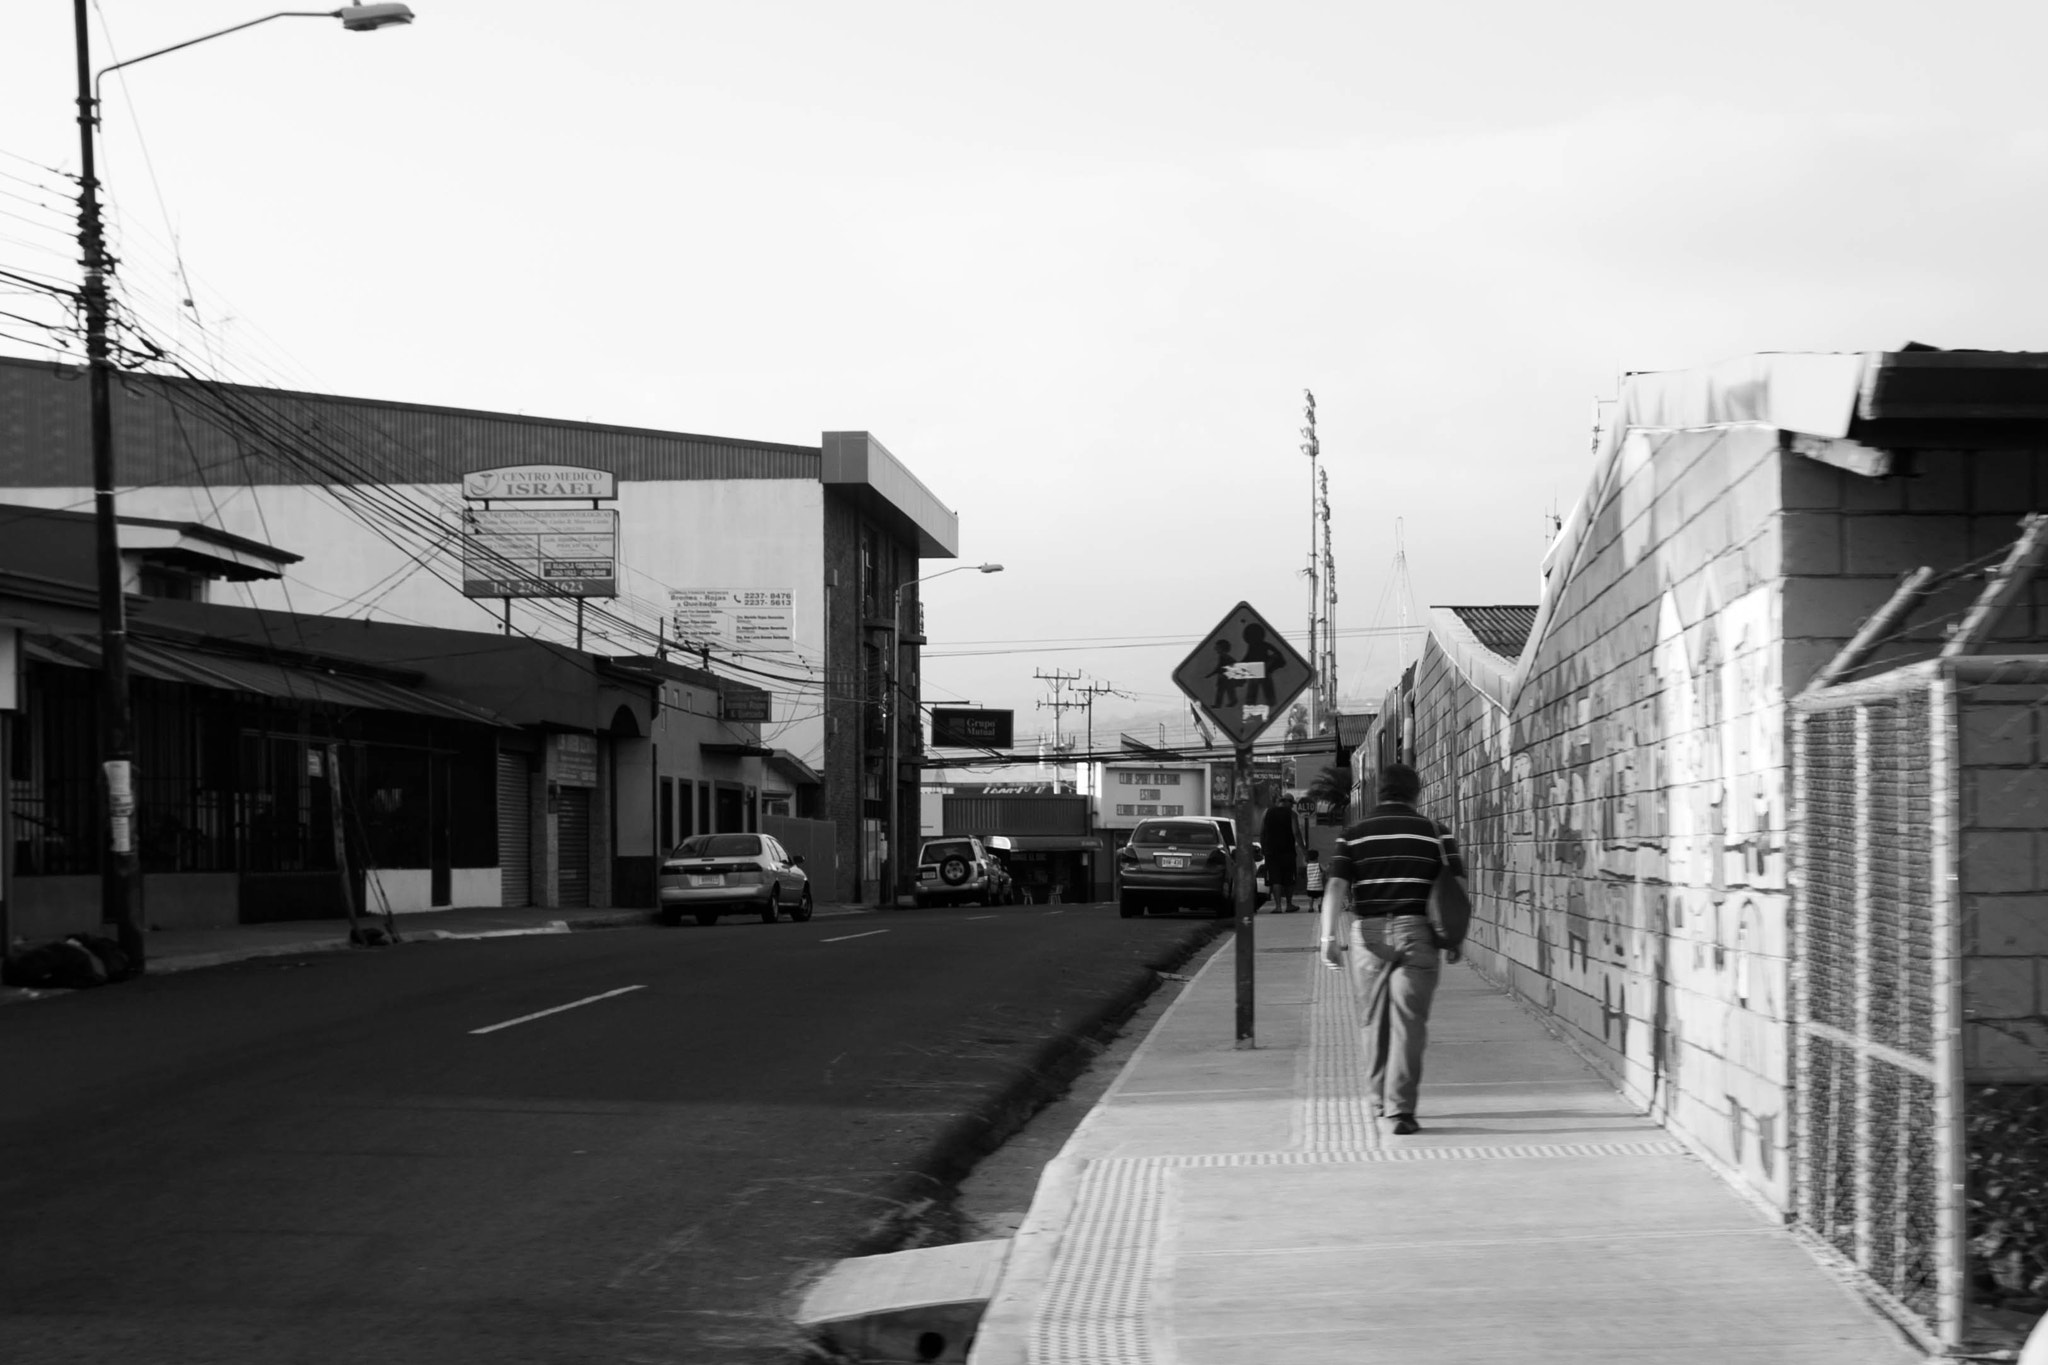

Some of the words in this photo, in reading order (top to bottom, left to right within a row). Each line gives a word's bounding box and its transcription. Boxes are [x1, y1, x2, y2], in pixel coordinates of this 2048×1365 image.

[502, 471, 551, 482] CENTRO
[555, 471, 602, 482] MEDICO
[506, 483, 602, 496] ISRAEL
[966, 717, 996, 729] Grupo
[966, 727, 996, 736] Mutual
